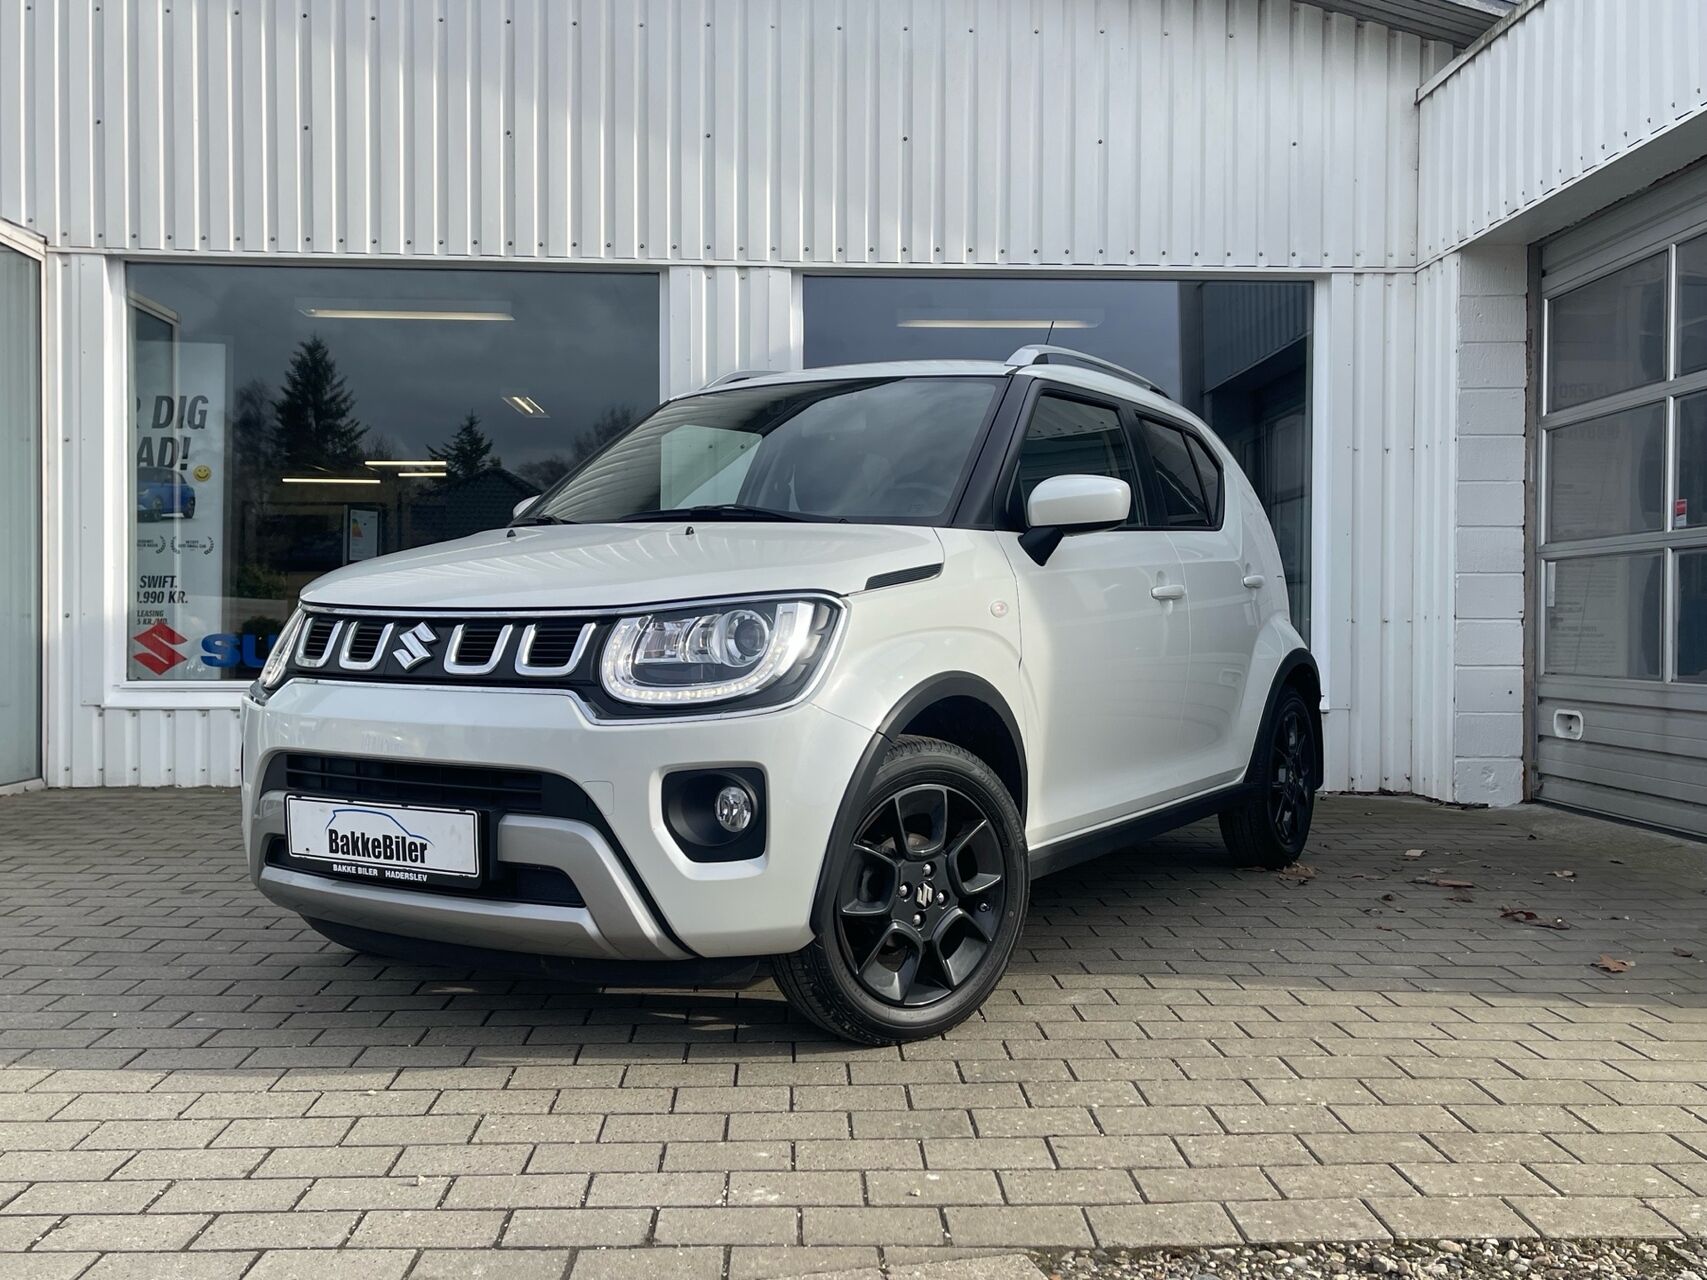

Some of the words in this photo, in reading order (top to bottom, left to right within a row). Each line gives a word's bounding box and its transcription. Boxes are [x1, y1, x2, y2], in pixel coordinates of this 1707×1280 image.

[152, 396, 209, 430] DIG
[139, 575, 178, 588] SWIFT.
[168, 591, 188, 604] KR.
[329, 829, 427, 863] BakkeBiler
[333, 864, 356, 873] BAKKE
[357, 867, 378, 876] BILER
[385, 870, 427, 881] HADERSLEV
